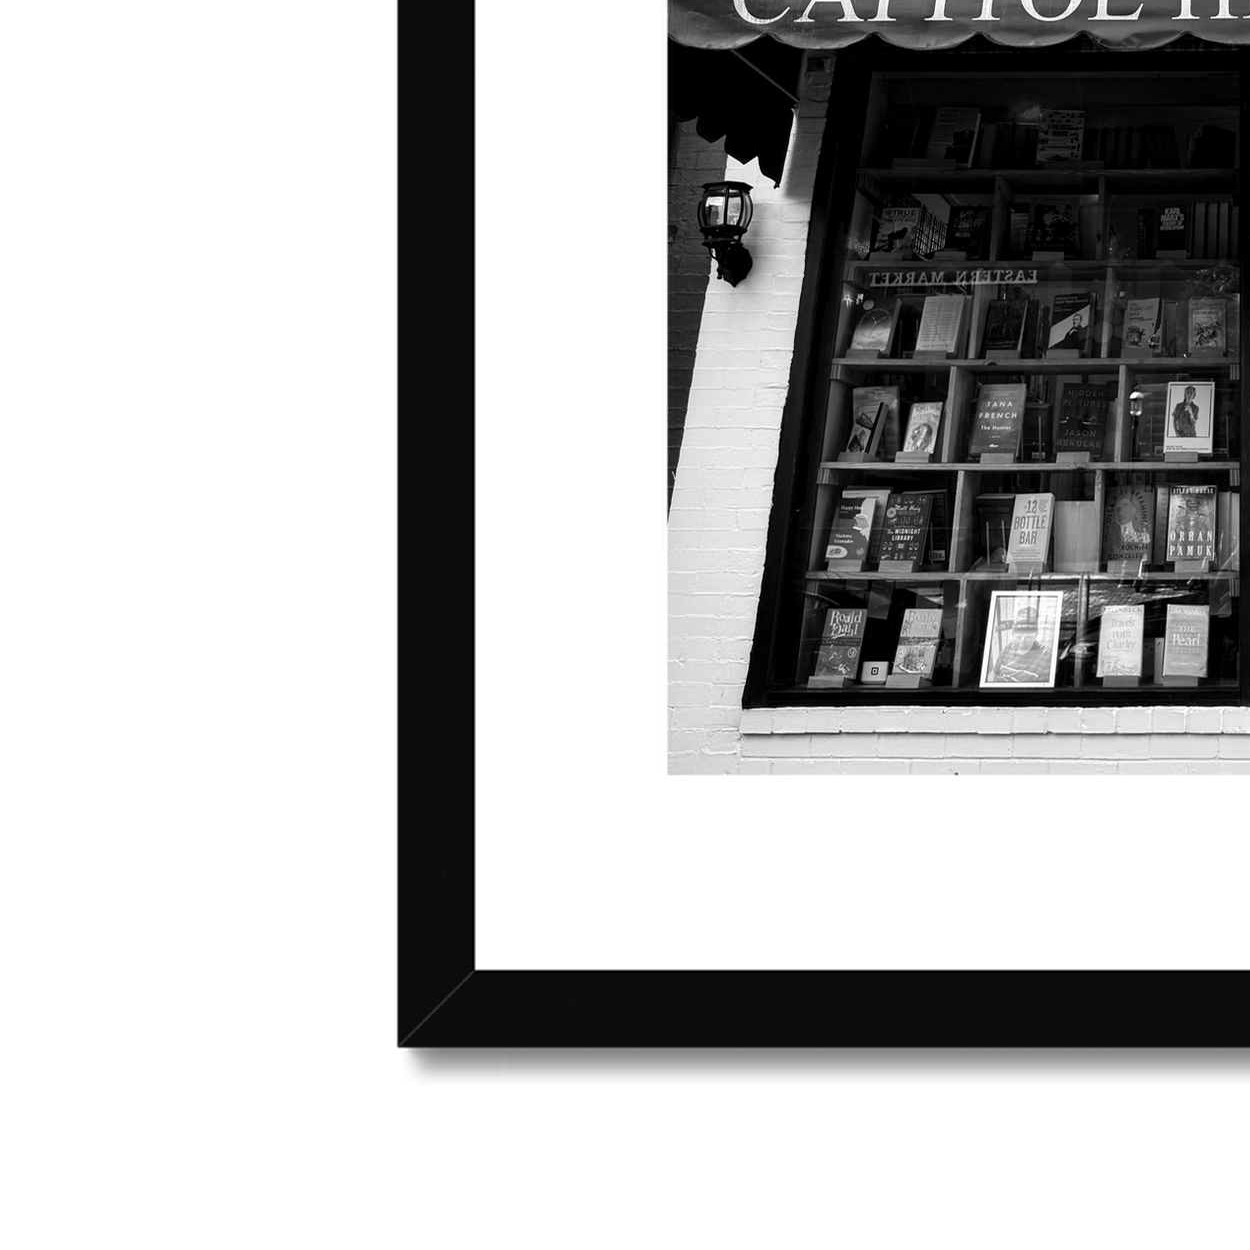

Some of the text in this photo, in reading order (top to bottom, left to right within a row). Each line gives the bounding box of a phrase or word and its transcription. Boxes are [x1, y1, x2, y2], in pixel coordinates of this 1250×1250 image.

[1068, 389, 1105, 398] HIDDEN
[1062, 398, 1107, 408] PITURES
[979, 412, 1018, 420] FRENCH
[1063, 429, 1097, 438] JASON
[1056, 438, 1102, 449] REKULAK
[1013, 515, 1047, 530] BOTTLE
[1019, 531, 1037, 545] BAR
[1170, 530, 1213, 542] ORHAN
[1170, 545, 1213, 556] PAMUK
[830, 610, 863, 626] Roald
[1111, 617, 1136, 628] Travels
[831, 623, 859, 637] Dahl
[1112, 628, 1132, 639] with
[1172, 633, 1201, 646] Pearl
[1107, 639, 1138, 652] Charley
